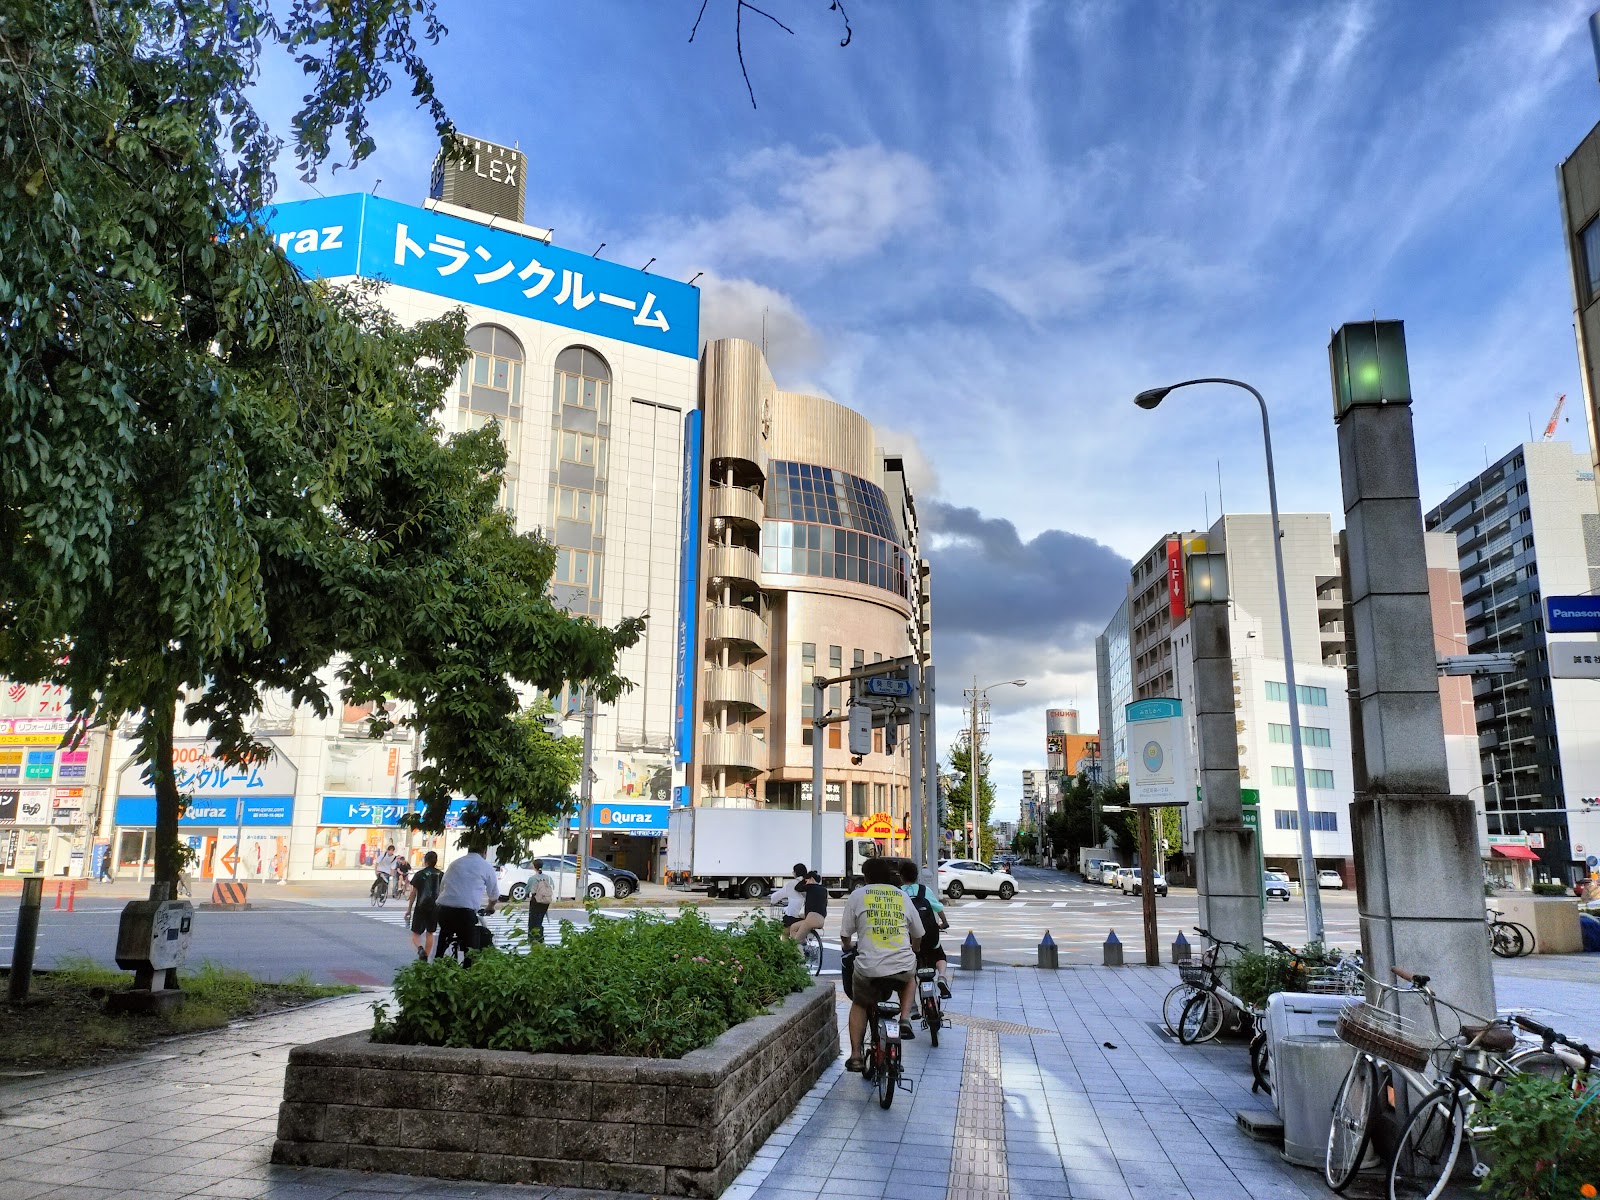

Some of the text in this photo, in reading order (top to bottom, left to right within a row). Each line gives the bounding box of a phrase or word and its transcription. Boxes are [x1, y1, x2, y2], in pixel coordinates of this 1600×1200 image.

[394, 223, 671, 333] トランクルーム
[1172, 559, 1180, 579] 1F
[1553, 609, 1600, 618] Panason
[677, 621, 687, 688] キュラーズ
[186, 806, 226, 820] Quraz
[611, 811, 653, 825] Quraz
[866, 889, 903, 897] ORIGINATORS
[866, 910, 878, 918] NEW
[881, 910, 891, 918] ERA
[872, 927, 884, 935] NEW
